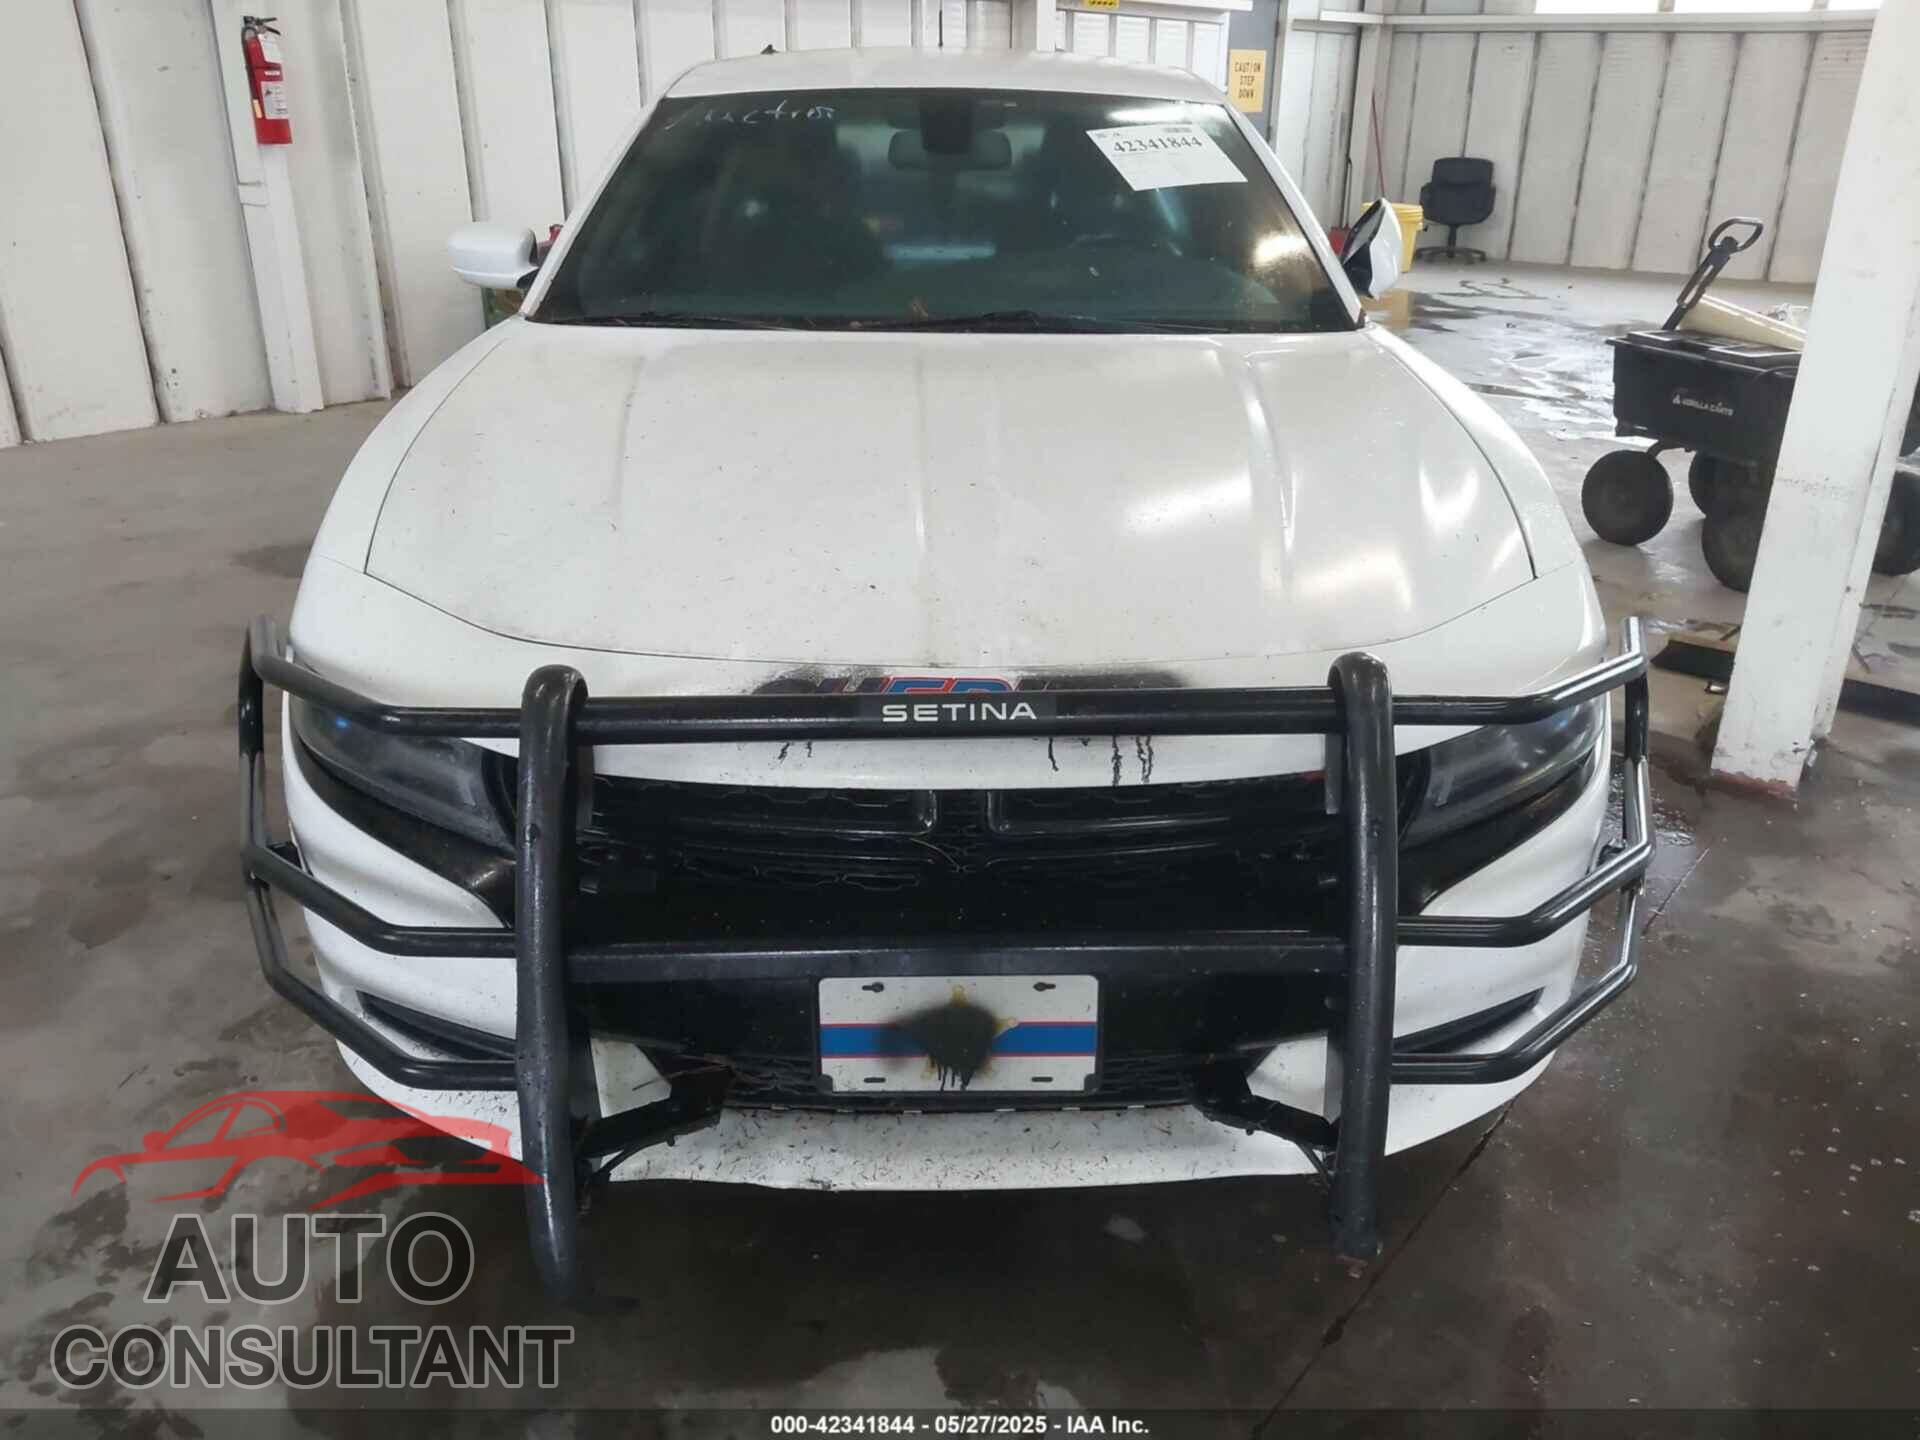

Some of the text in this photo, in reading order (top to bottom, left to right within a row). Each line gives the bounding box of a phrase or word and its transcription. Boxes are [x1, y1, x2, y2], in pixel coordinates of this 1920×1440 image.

[1234, 61, 1261, 73] CAUTION
[1239, 75, 1255, 86] STEP
[1238, 88, 1254, 98] DOWN
[1113, 136, 1203, 153] 42341844
[882, 702, 1037, 723] SETINA
